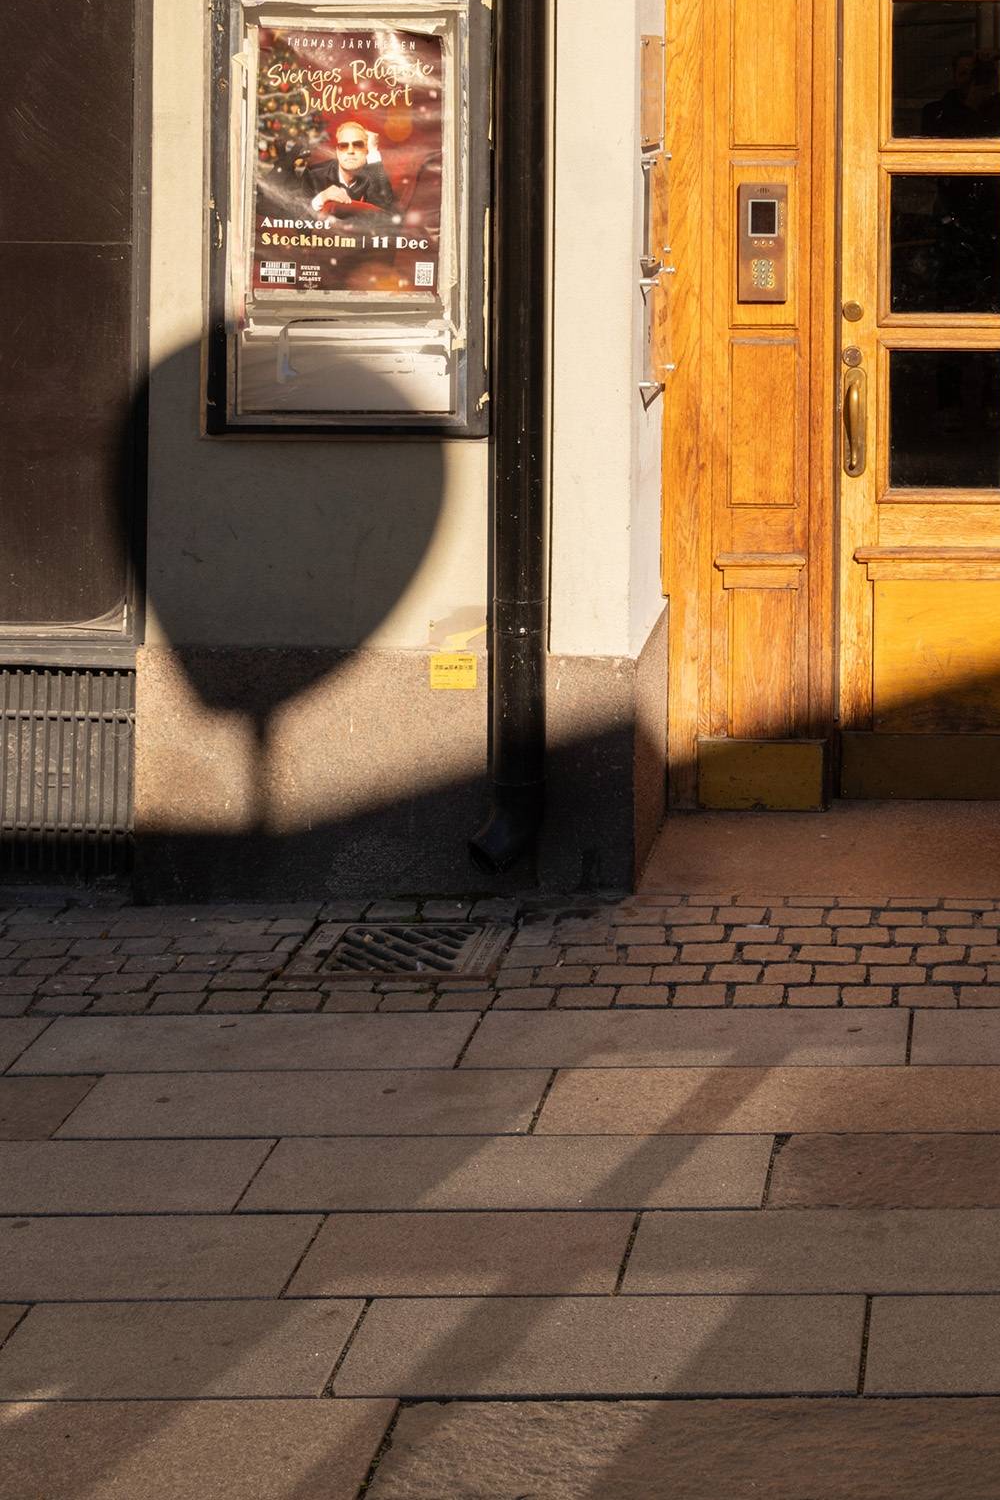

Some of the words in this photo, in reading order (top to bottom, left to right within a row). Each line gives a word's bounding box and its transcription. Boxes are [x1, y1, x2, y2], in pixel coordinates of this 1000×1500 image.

[287, 36, 333, 49] THOMAS
[341, 38, 415, 50] JÄRVHEEN
[267, 63, 342, 92] Sveriges
[349, 58, 434, 87] Roligste
[297, 84, 413, 117] Julkonsert
[260, 216, 332, 230] Annexet
[261, 232, 356, 248] Stockholm
[371, 236, 389, 249] 11
[396, 237, 429, 250] Dec
